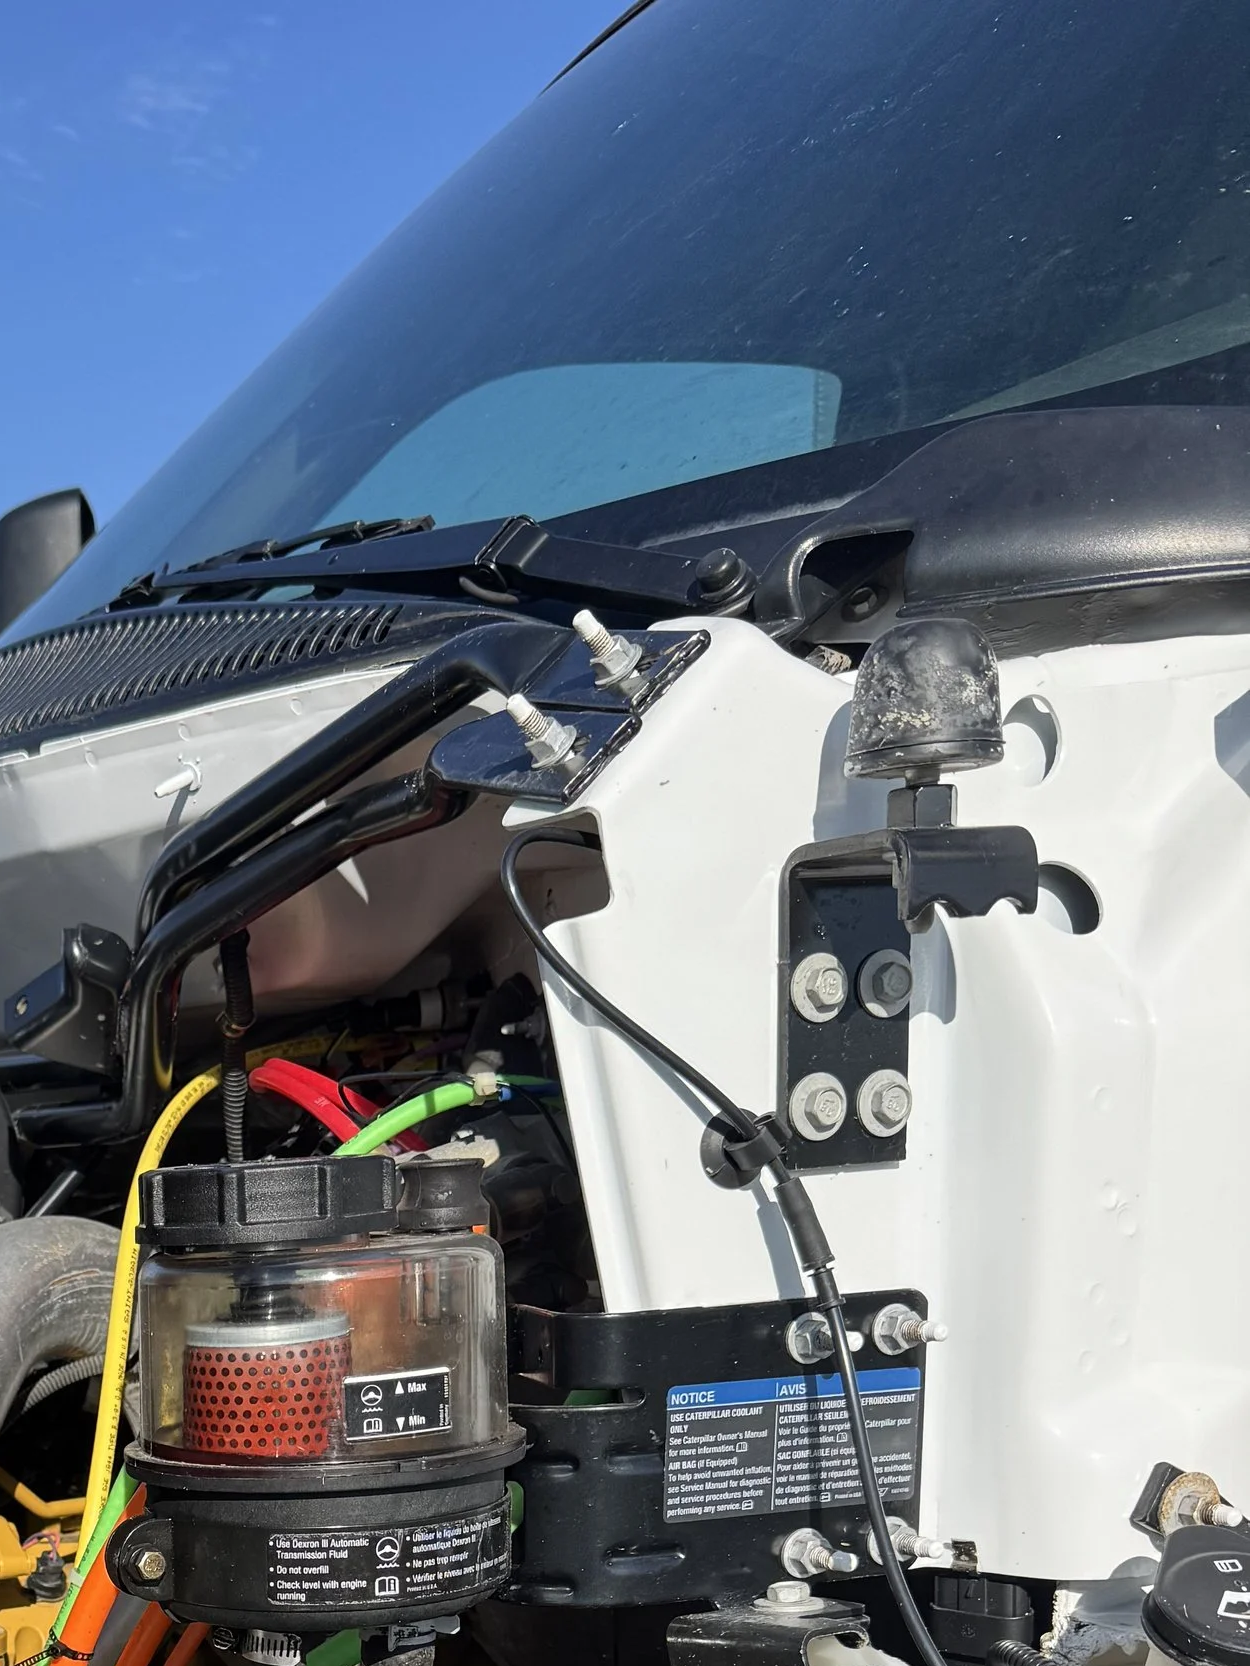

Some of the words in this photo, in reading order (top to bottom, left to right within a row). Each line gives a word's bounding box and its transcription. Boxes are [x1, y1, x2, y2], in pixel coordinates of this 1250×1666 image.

[408, 1382, 426, 1392] Max
[779, 1383, 807, 1396] AVIS
[671, 1391, 716, 1405] NOTICE
[779, 1402, 808, 1413] UTILISER
[820, 1399, 846, 1409] LIQUIDE
[860, 1394, 916, 1407] EFROIDISSEMENT
[409, 1415, 426, 1426] Min
[670, 1413, 684, 1422] USE
[685, 1409, 731, 1421] CATERPILLAR
[731, 1406, 764, 1417] COOLANT
[779, 1413, 822, 1424] CATERPILLAR
[670, 1425, 688, 1434] ONLY
[778, 1427, 791, 1436] Voir
[792, 1426, 798, 1434] le
[799, 1425, 817, 1433] Guide
[819, 1424, 827, 1432] du
[865, 1418, 896, 1429] Caterpillar
[897, 1418, 912, 1427] pour
[669, 1437, 681, 1446] See
[683, 1434, 716, 1444] Caterpillar
[717, 1432, 743, 1441] Owner's
[744, 1430, 768, 1439] Manual
[777, 1439, 792, 1448] plus
[669, 1449, 678, 1457] for
[679, 1448, 696, 1456] more
[698, 1445, 735, 1454] information.
[777, 1451, 791, 1460] SAC
[668, 1461, 681, 1470] AIR
[682, 1460, 696, 1469] BAG
[697, 1460, 705, 1469] (if
[706, 1457, 738, 1468] Equipped)
[776, 1463, 791, 1472] Pour
[792, 1461, 808, 1469] aider
[842, 1458, 850, 1466] un
[678, 1473, 692, 1482] help
[693, 1471, 711, 1479] avoid
[712, 1468, 744, 1477] unwanted
[776, 1475, 788, 1483] voir
[789, 1474, 796, 1482] le
[828, 1468, 859, 1479] réparation
[884, 1463, 913, 1473] méthodes
[680, 1484, 704, 1492] Service
[705, 1481, 728, 1490] Manual
[730, 1479, 738, 1487] for
[739, 1477, 772, 1487] diagnostic
[775, 1486, 784, 1494] de
[784, 1483, 817, 1493] diagnostic
[825, 1480, 859, 1490] d'entretien
[667, 1497, 679, 1505] and
[681, 1495, 704, 1503] service
[705, 1492, 741, 1502] procedures
[743, 1489, 763, 1497] before
[775, 1496, 788, 1506] tout
[667, 1507, 702, 1518] performing
[703, 1506, 715, 1514] any
[717, 1503, 741, 1512] service.
[412, 1532, 435, 1542] Utiliser
[436, 1530, 442, 1538] le
[276, 1539, 290, 1549] Use
[292, 1539, 319, 1548] Dexron
[330, 1538, 369, 1547] Automatic
[412, 1541, 451, 1553] automatique
[452, 1536, 471, 1546] Dexron
[276, 1550, 327, 1559] Transmission
[329, 1549, 348, 1559] Fluid
[412, 1559, 422, 1568] Ne
[423, 1559, 435, 1568] pas
[437, 1555, 448, 1565] trop
[276, 1565, 287, 1574] Do
[289, 1565, 302, 1574] not
[303, 1565, 329, 1574] overfill
[412, 1572, 436, 1583] Vérifier
[437, 1571, 443, 1579] le
[443, 1568, 462, 1579] niveau
[463, 1565, 475, 1575] avec
[276, 1580, 301, 1589] Check
[302, 1580, 320, 1589] level
[322, 1580, 339, 1589] with
[340, 1579, 367, 1590] engine
[277, 1592, 306, 1602] running
